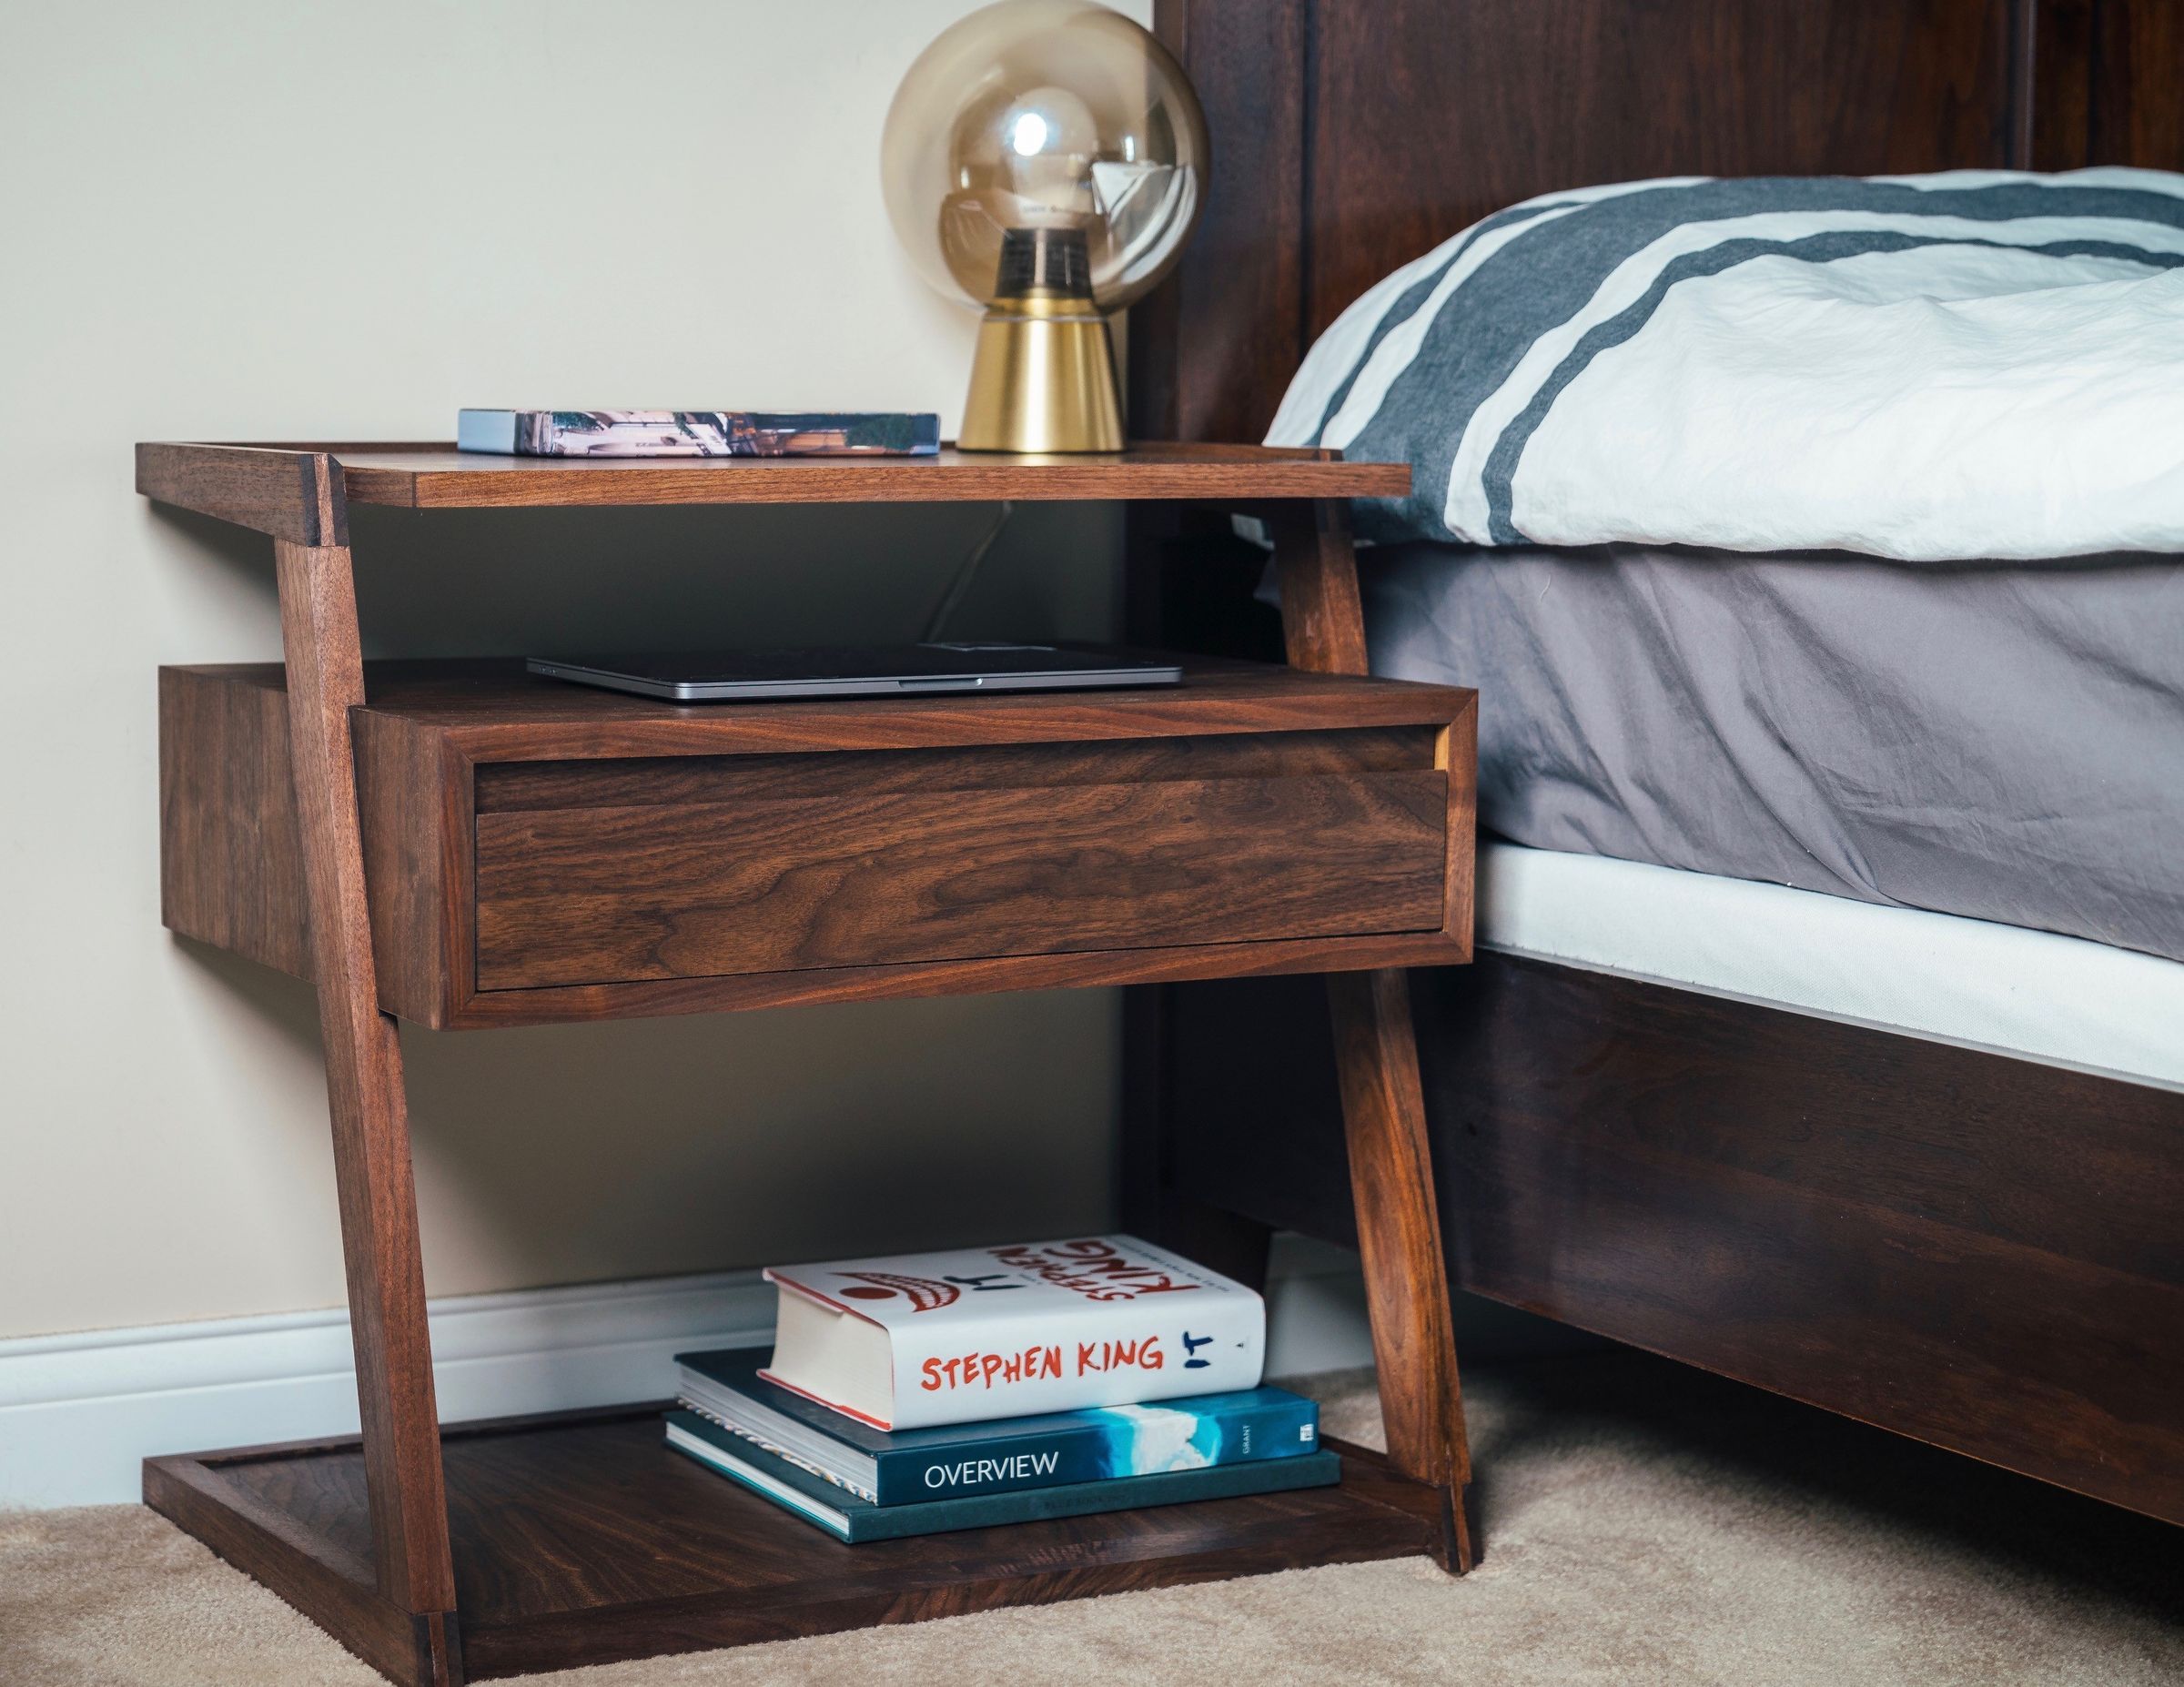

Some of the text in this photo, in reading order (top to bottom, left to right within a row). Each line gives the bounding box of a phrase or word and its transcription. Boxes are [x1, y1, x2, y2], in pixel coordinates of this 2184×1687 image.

[943, 1274, 1027, 1292] IT
[1042, 1239, 1201, 1295] KING
[921, 1336, 1165, 1391] STEPHEN KING
[1182, 1331, 1214, 1369] IT
[1242, 1425, 1251, 1454] GRANT
[925, 1451, 1059, 1489] OVERVIEW
